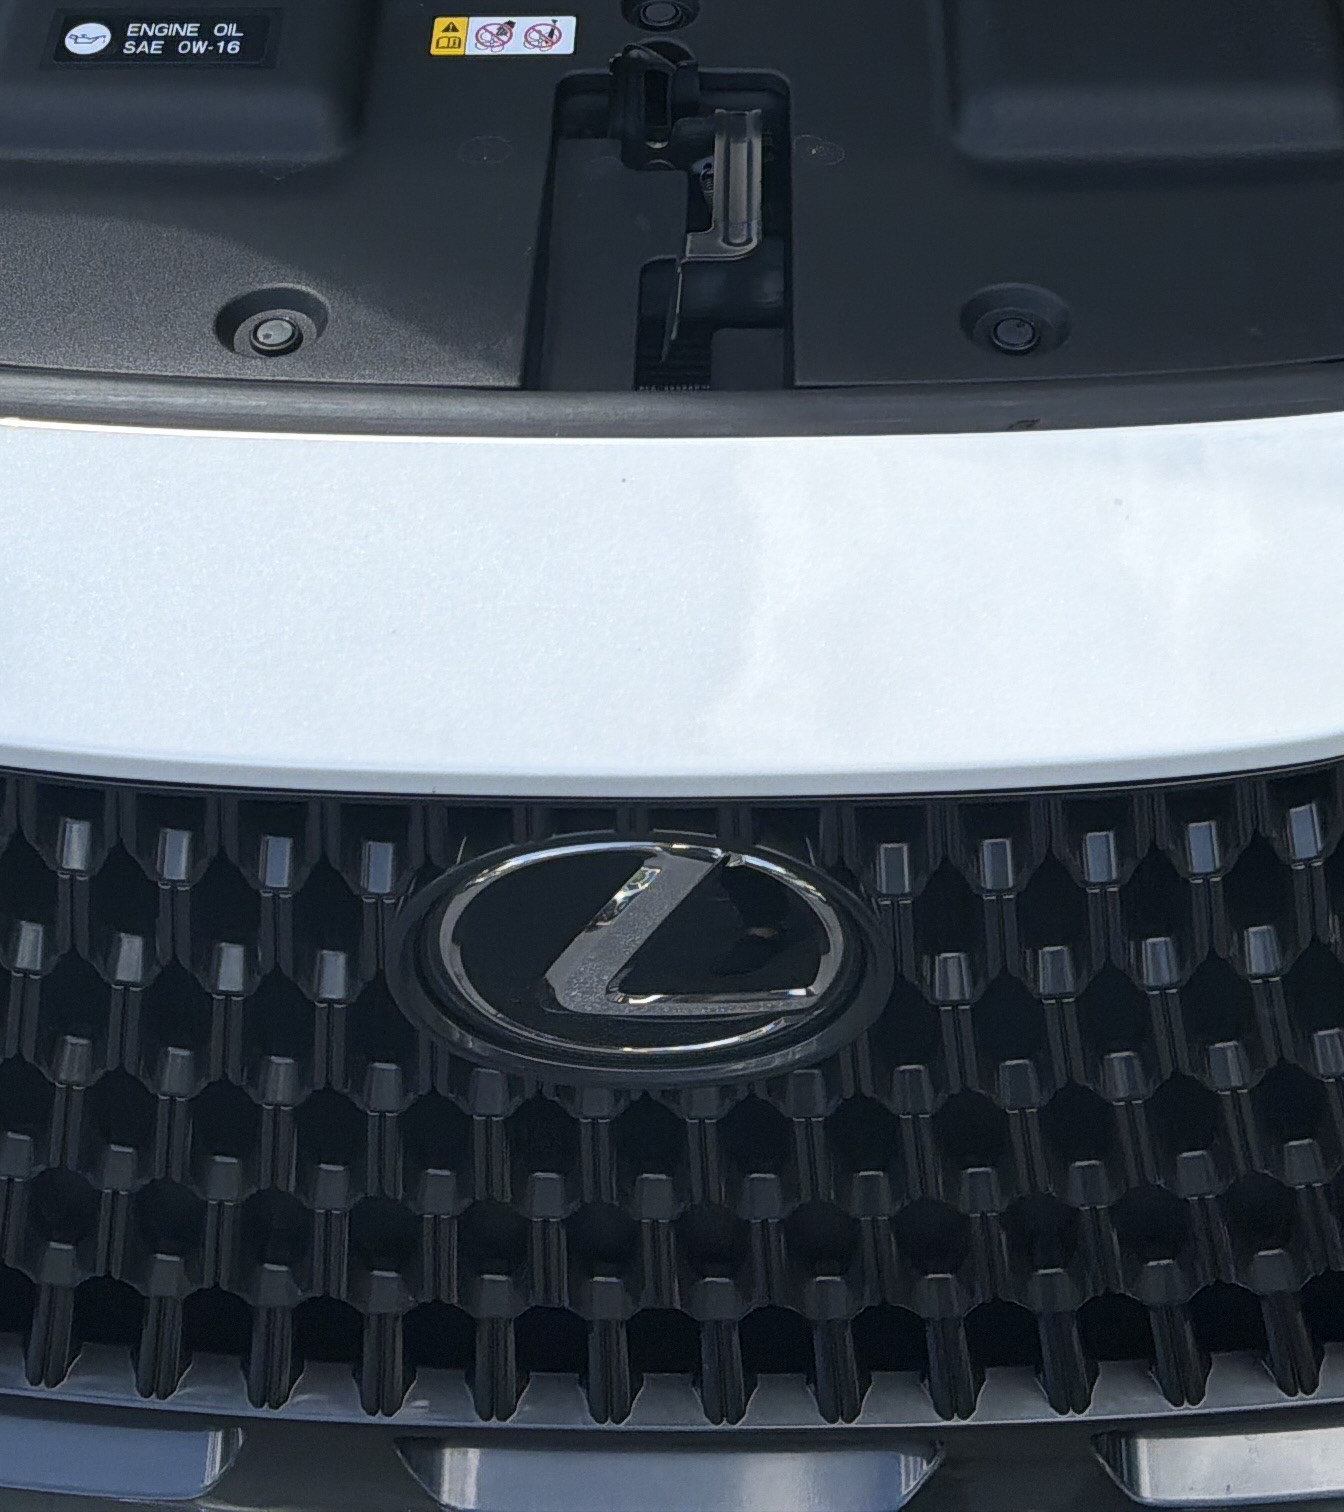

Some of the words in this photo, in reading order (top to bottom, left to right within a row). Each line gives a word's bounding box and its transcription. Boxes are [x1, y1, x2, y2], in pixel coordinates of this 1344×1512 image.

[126, 23, 200, 37] ENGINE
[213, 23, 244, 37] OIL
[122, 41, 165, 55] SAE
[177, 41, 241, 55] 0W-16
